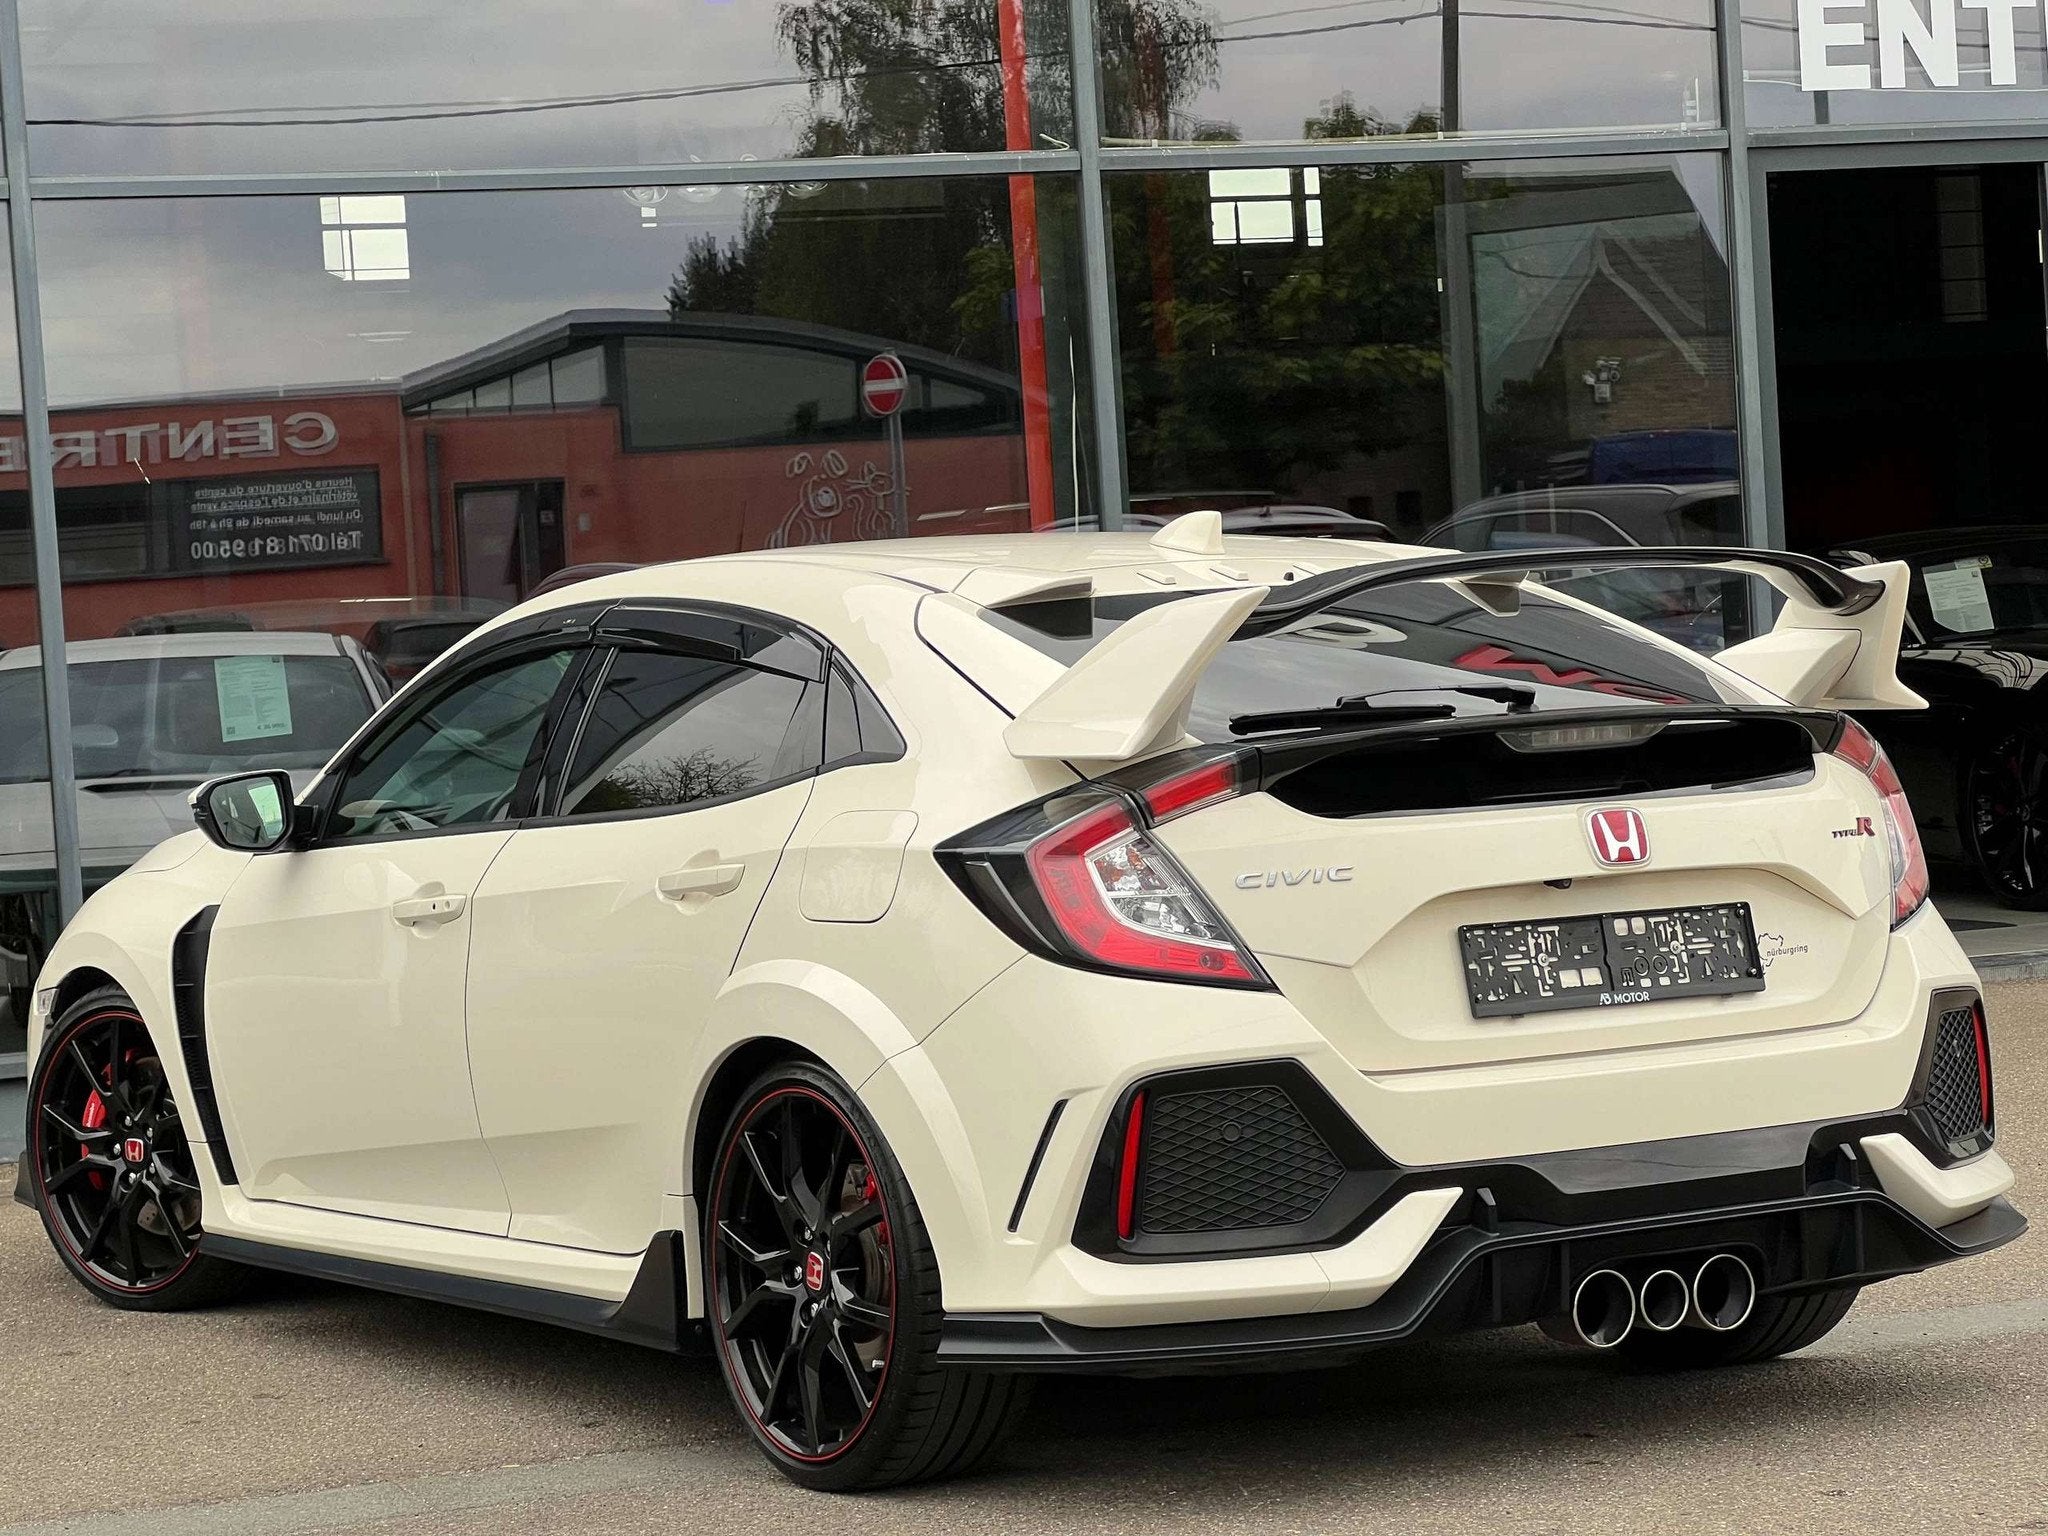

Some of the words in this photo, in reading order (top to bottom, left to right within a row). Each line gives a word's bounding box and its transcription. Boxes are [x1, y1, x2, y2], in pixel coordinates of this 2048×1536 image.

[1797, 0, 2048, 91] ENT
[1856, 816, 1876, 837] R
[1235, 865, 1354, 889] CIVIC
[1766, 944, 1809, 957] nürburgring
[1614, 991, 1650, 1004] MOTOR
